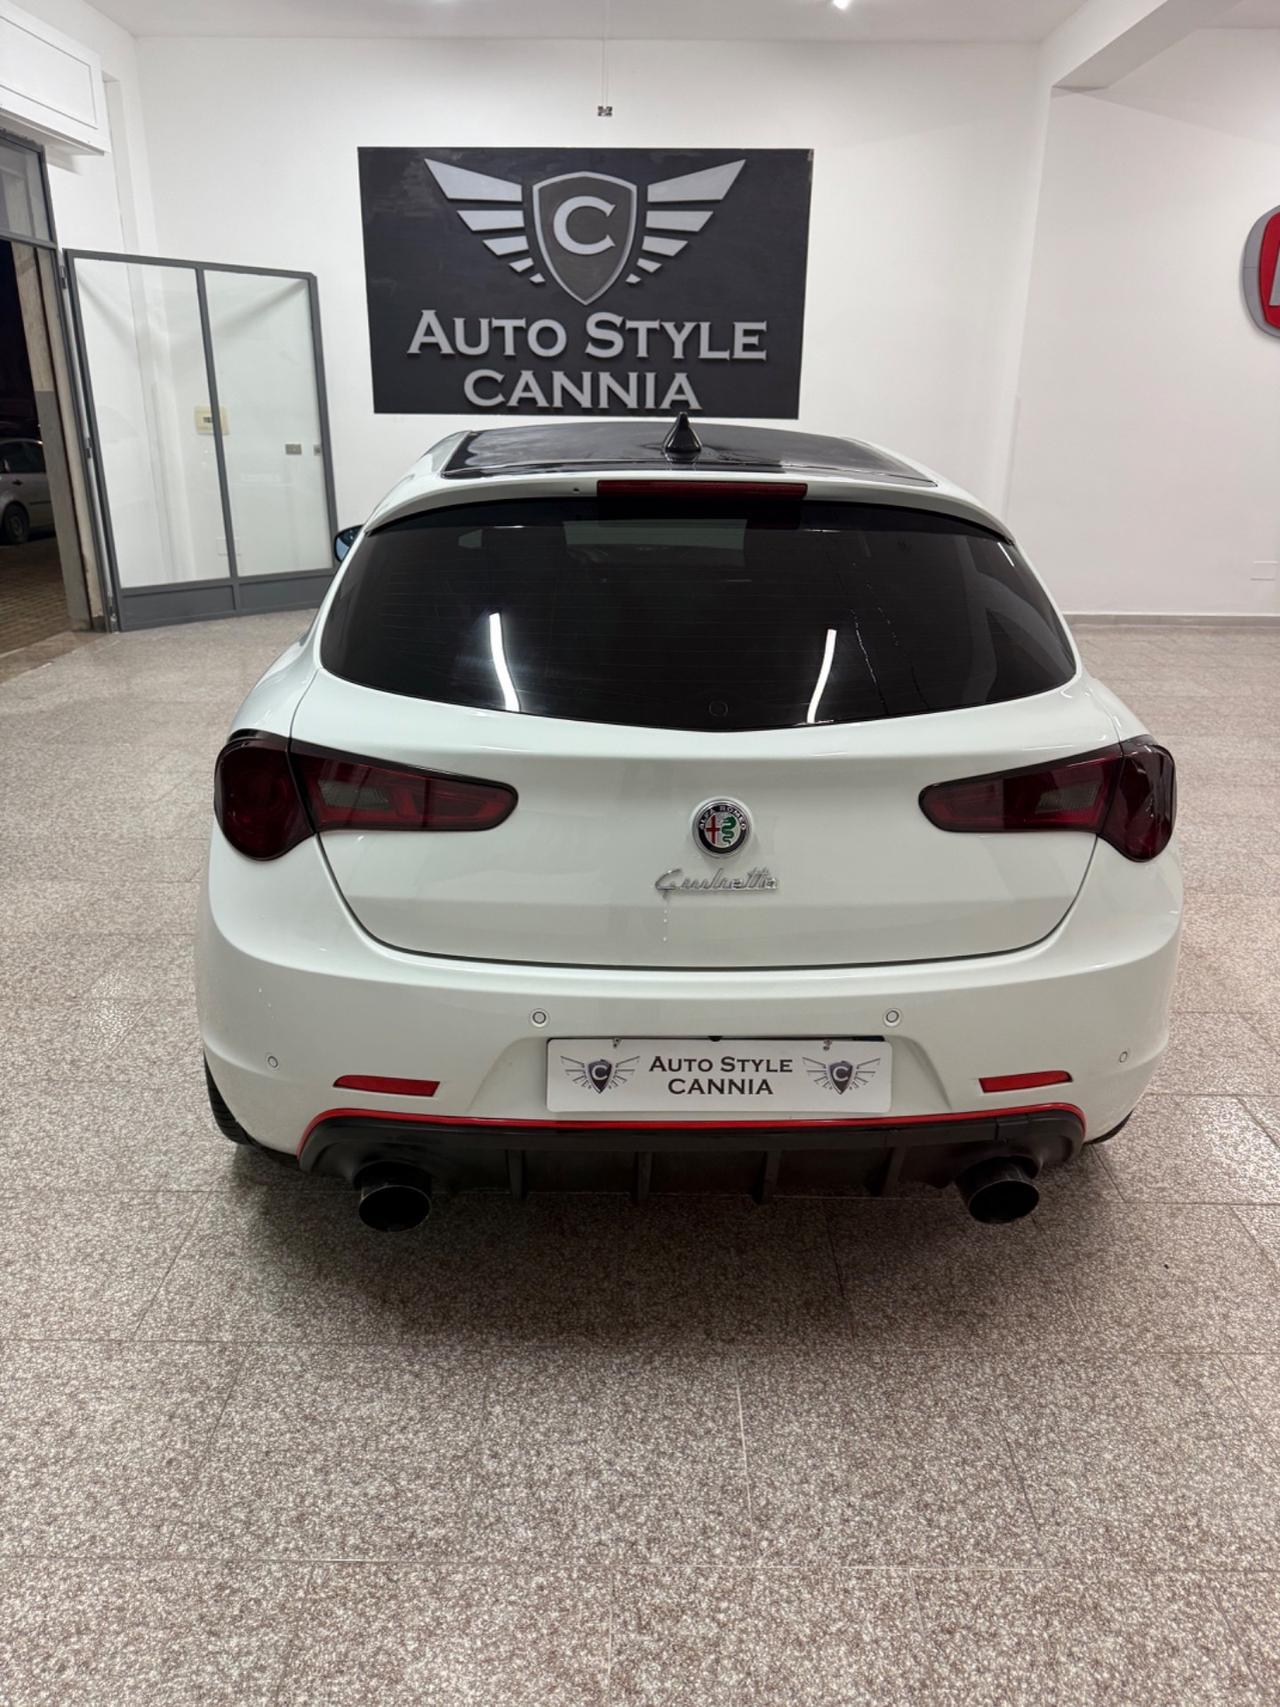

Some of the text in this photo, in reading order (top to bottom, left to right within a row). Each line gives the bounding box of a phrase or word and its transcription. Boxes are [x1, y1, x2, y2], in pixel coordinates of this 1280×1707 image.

[552, 195, 617, 256] C
[406, 309, 768, 360] AUTO STYLE
[463, 368, 703, 411] CANNIA
[648, 1056, 794, 1074] AUTO STYLE
[667, 1078, 774, 1095] CANNIA
